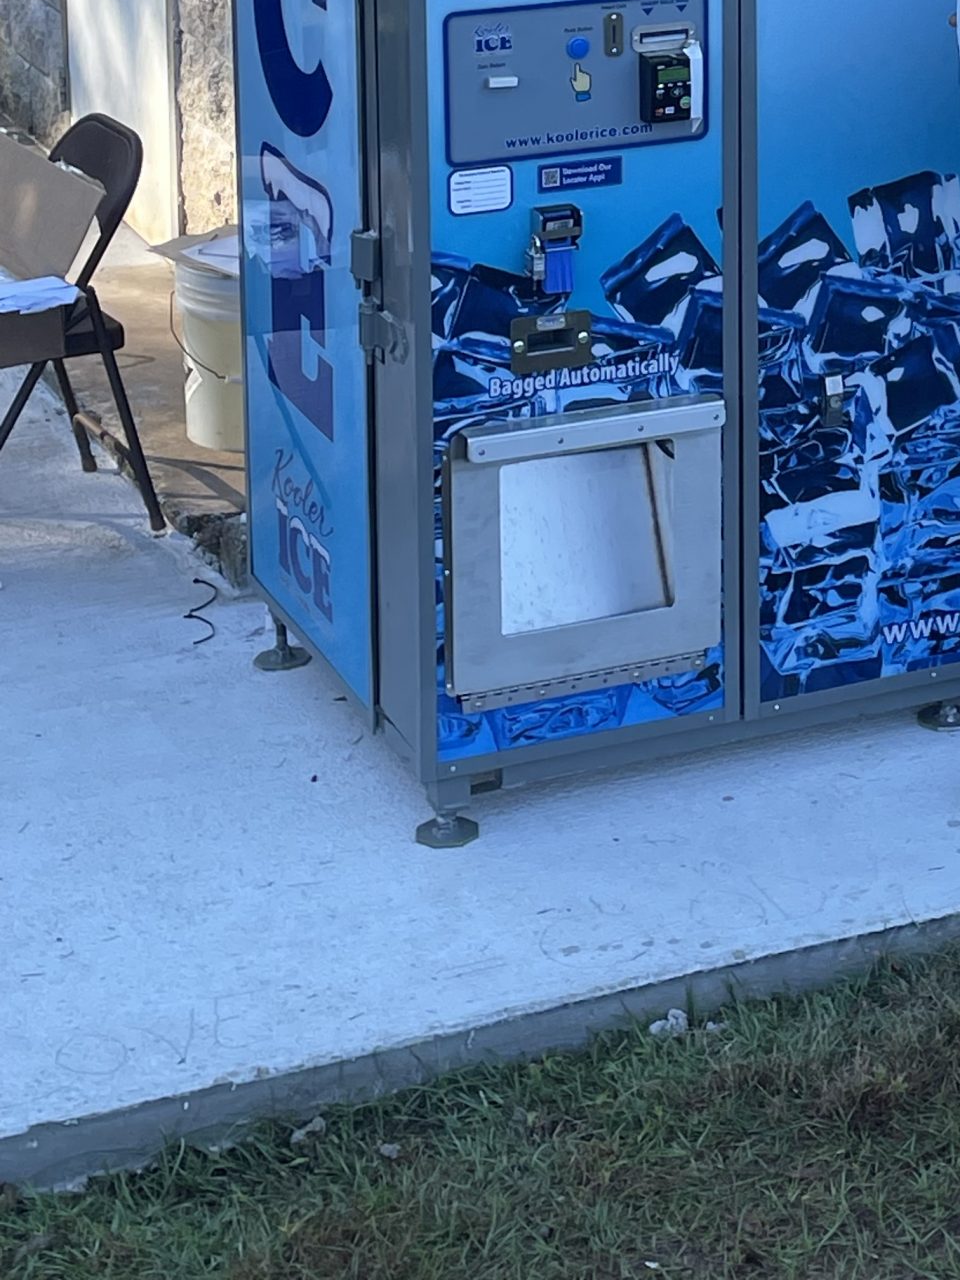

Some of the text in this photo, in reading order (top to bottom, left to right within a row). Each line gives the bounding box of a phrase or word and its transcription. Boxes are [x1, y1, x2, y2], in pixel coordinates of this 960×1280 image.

[475, 34, 512, 52] ICE
[505, 123, 653, 148] www.koolerice.com
[562, 163, 612, 175] Download Our
[562, 175, 588, 185] Locator
[489, 351, 680, 398] Bagged Automatically
[271, 447, 334, 538] Kooler
[275, 497, 334, 624] ICE
